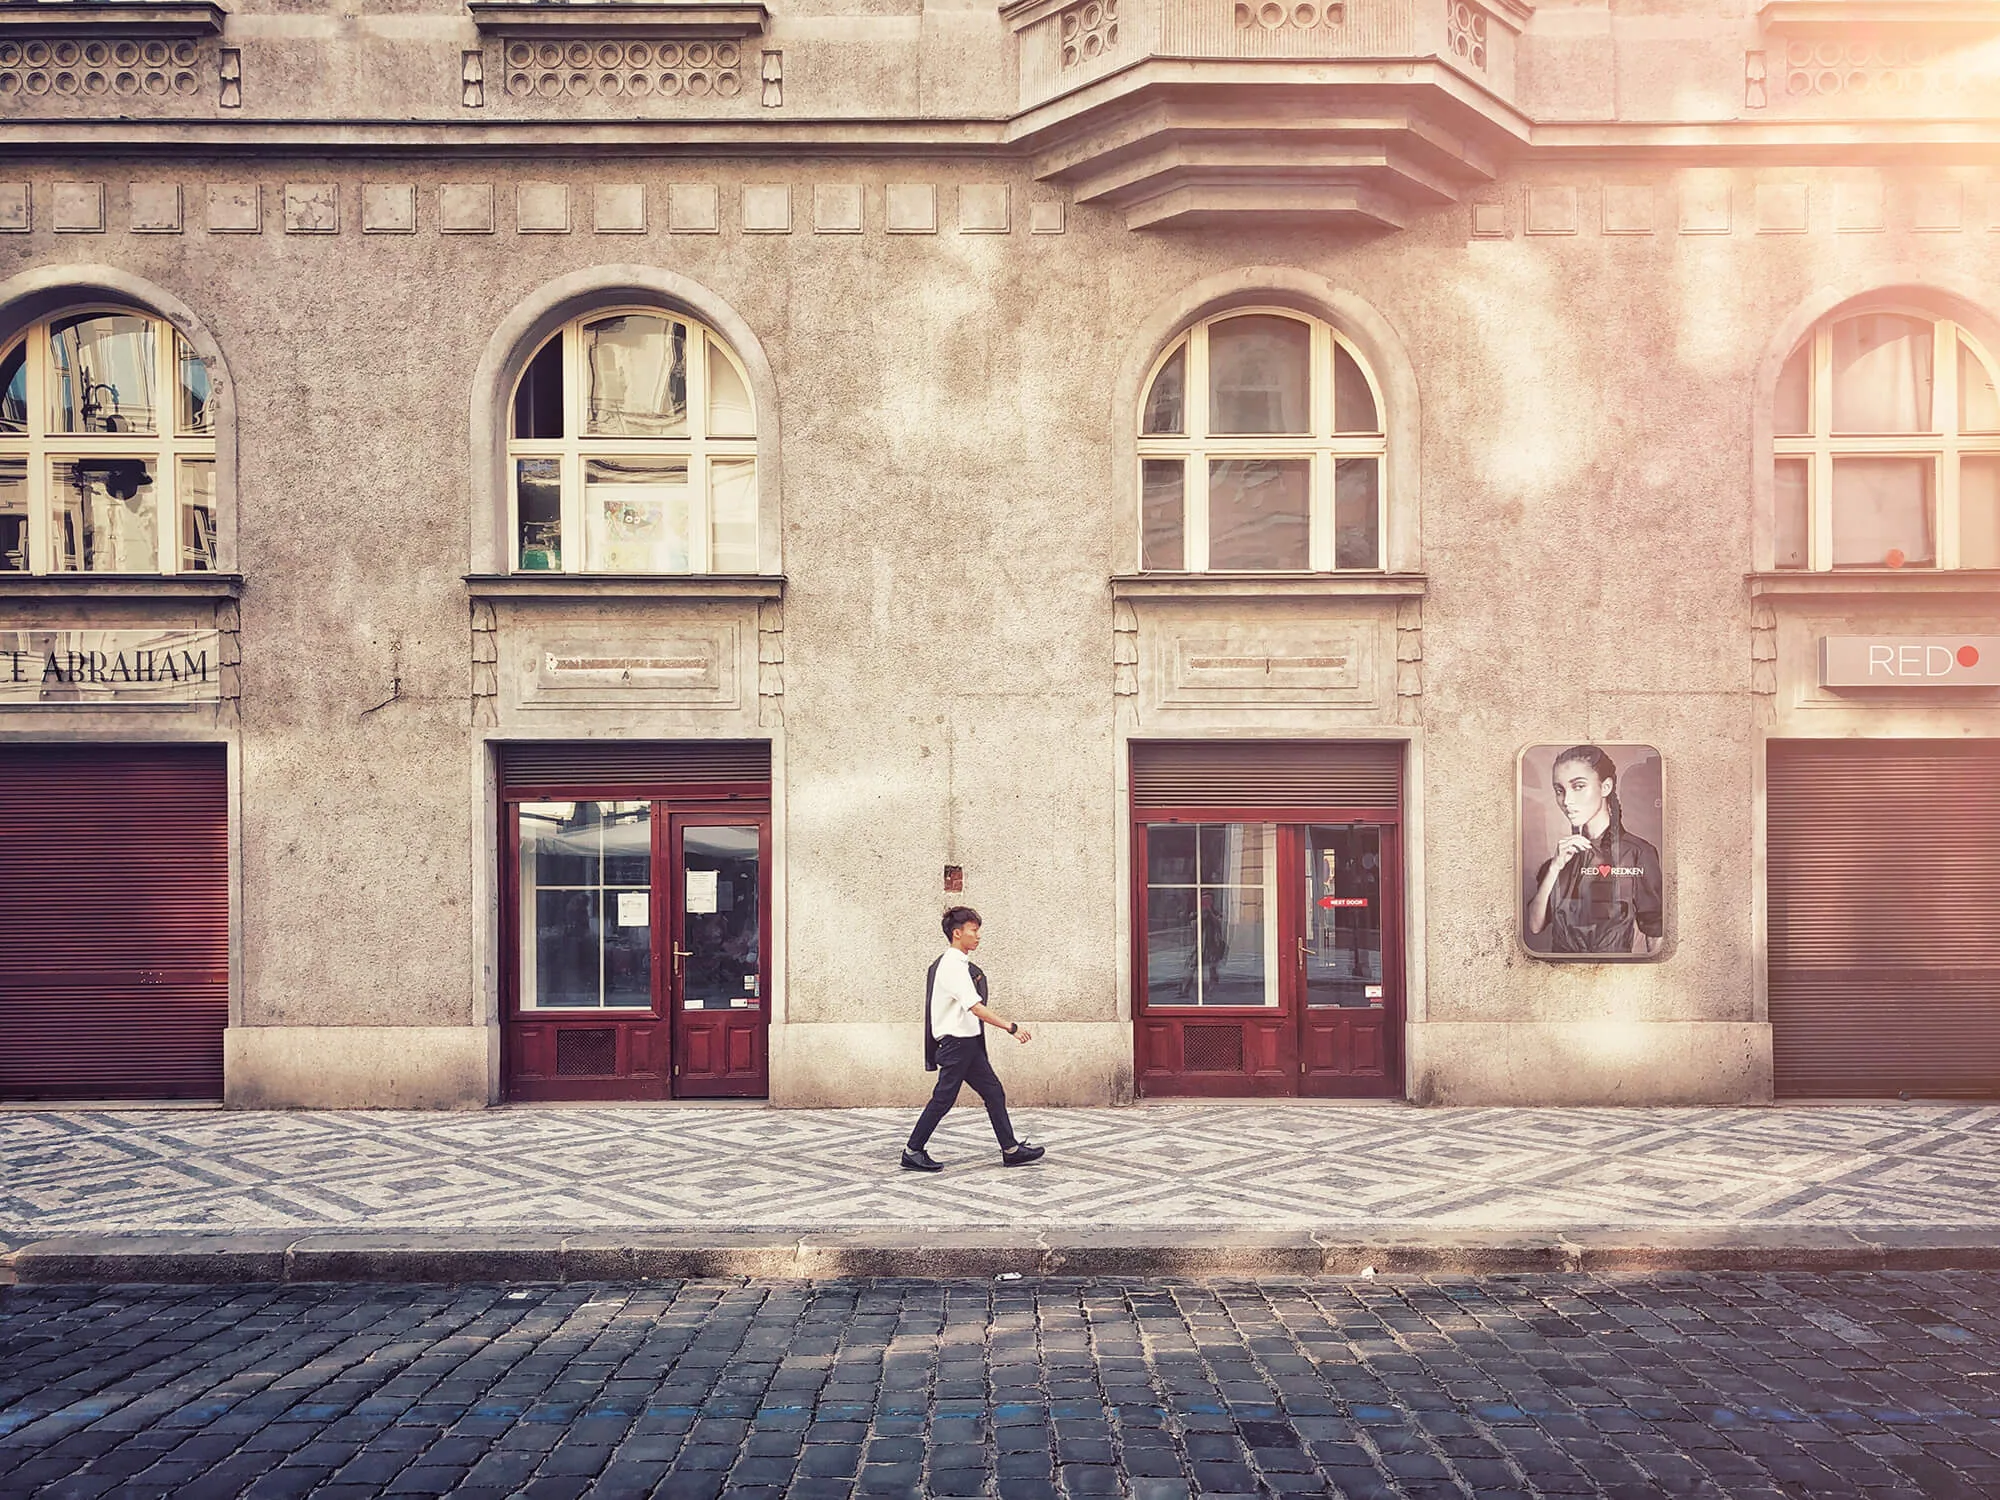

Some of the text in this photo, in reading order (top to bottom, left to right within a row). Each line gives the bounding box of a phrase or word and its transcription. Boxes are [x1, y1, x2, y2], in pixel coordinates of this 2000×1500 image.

[42, 650, 209, 683] ABRAHAM
[1869, 645, 1953, 676] RED
[1580, 867, 1644, 876] RED REDKEN
